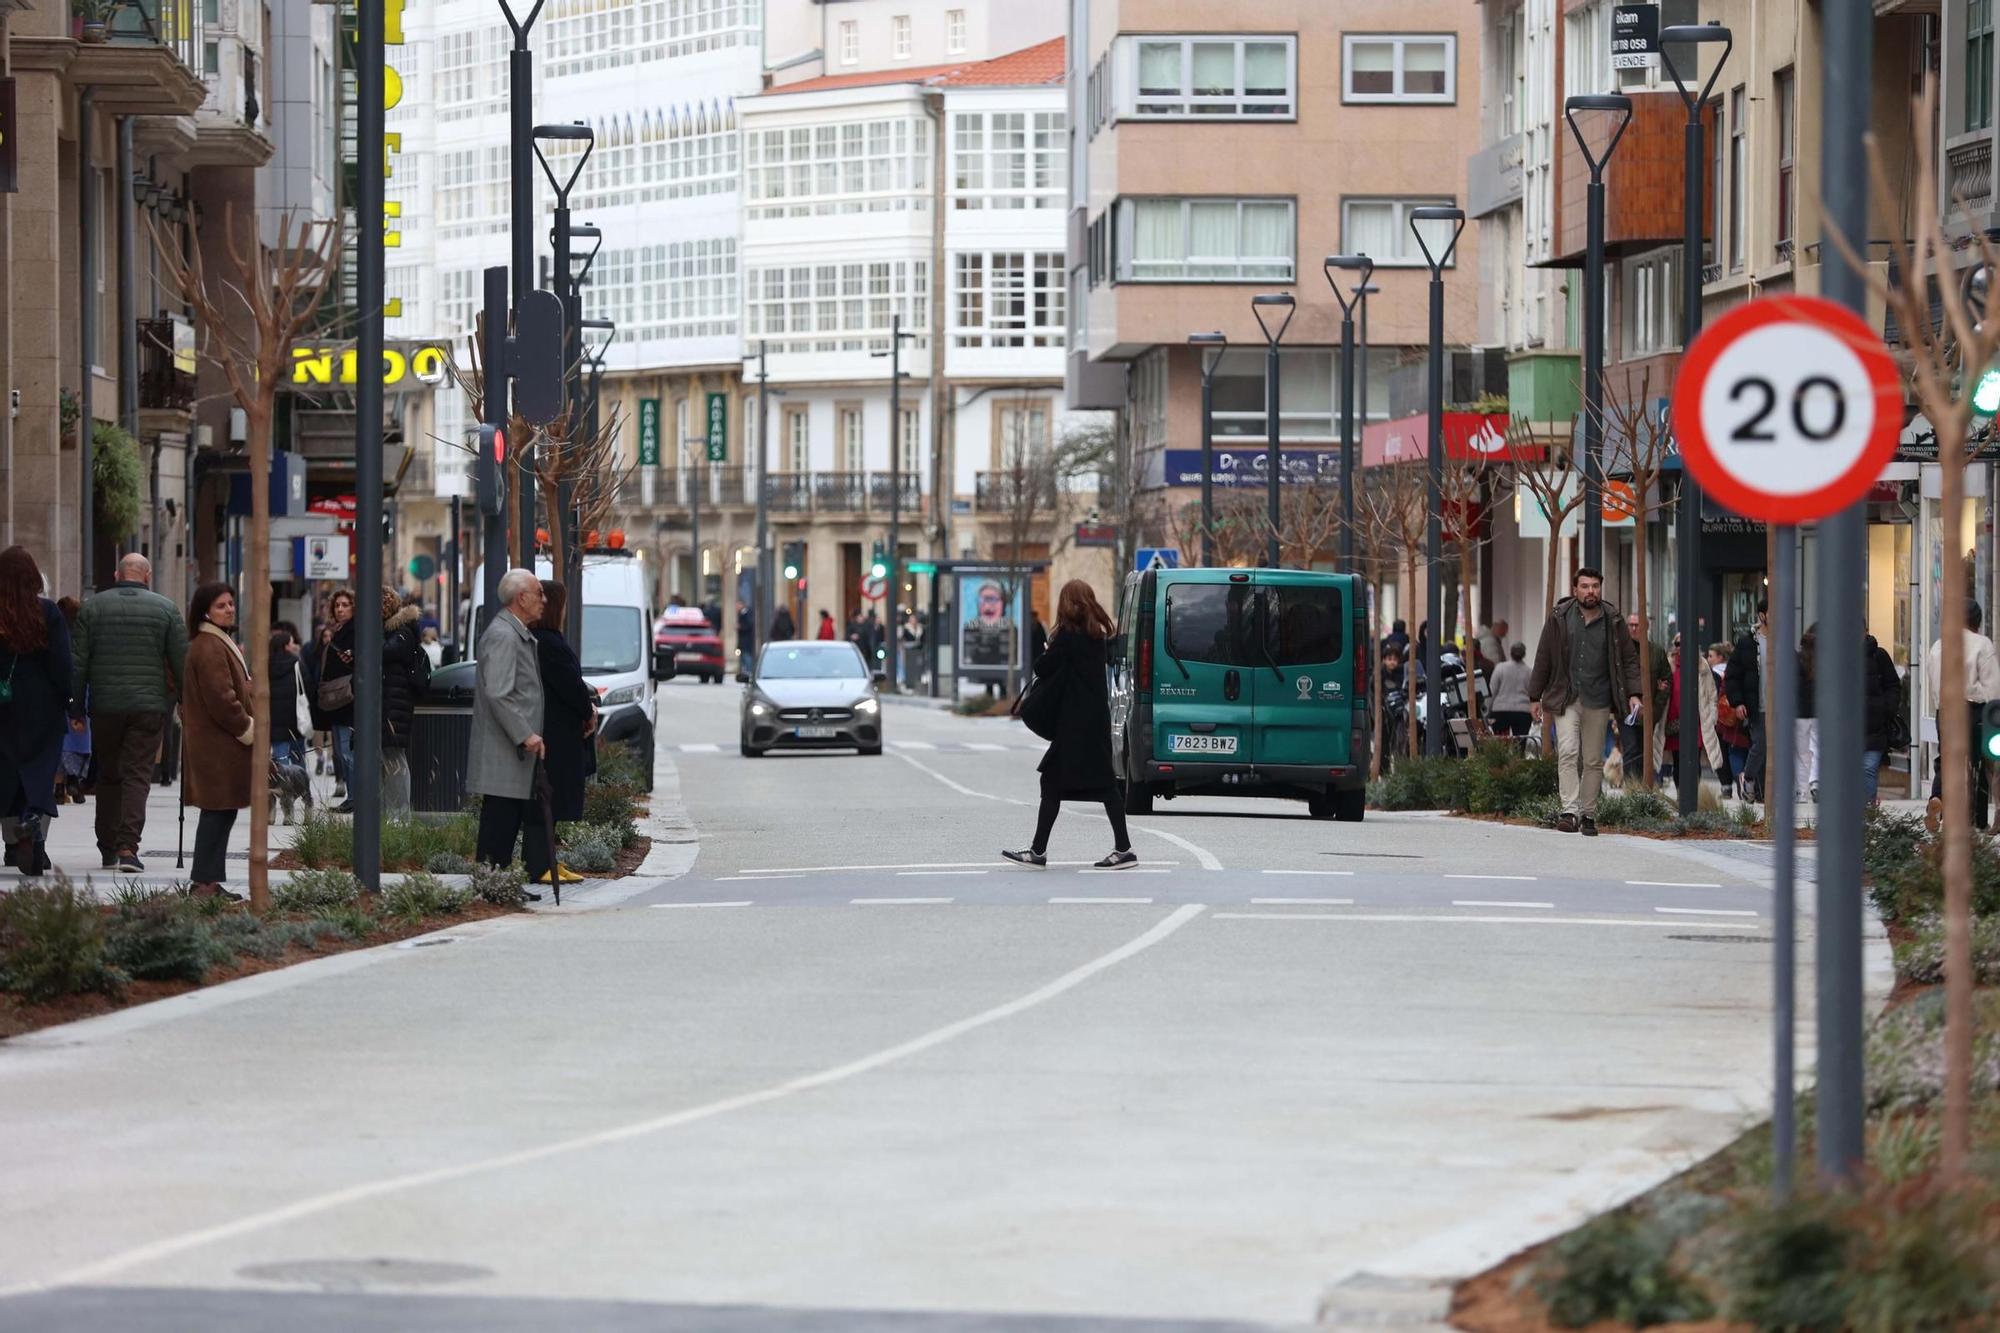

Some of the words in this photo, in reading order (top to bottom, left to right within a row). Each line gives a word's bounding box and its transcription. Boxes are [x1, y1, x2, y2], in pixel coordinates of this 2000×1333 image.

[1630, 38, 1647, 49] 058
[1729, 374, 1846, 442] 20
[643, 401, 655, 463] ADAMS
[711, 396, 723, 459] ADAMS
[1160, 687, 1197, 697] RENAULT
[1176, 736, 1208, 749] 7823
[1211, 737, 1235, 750] BWZ
